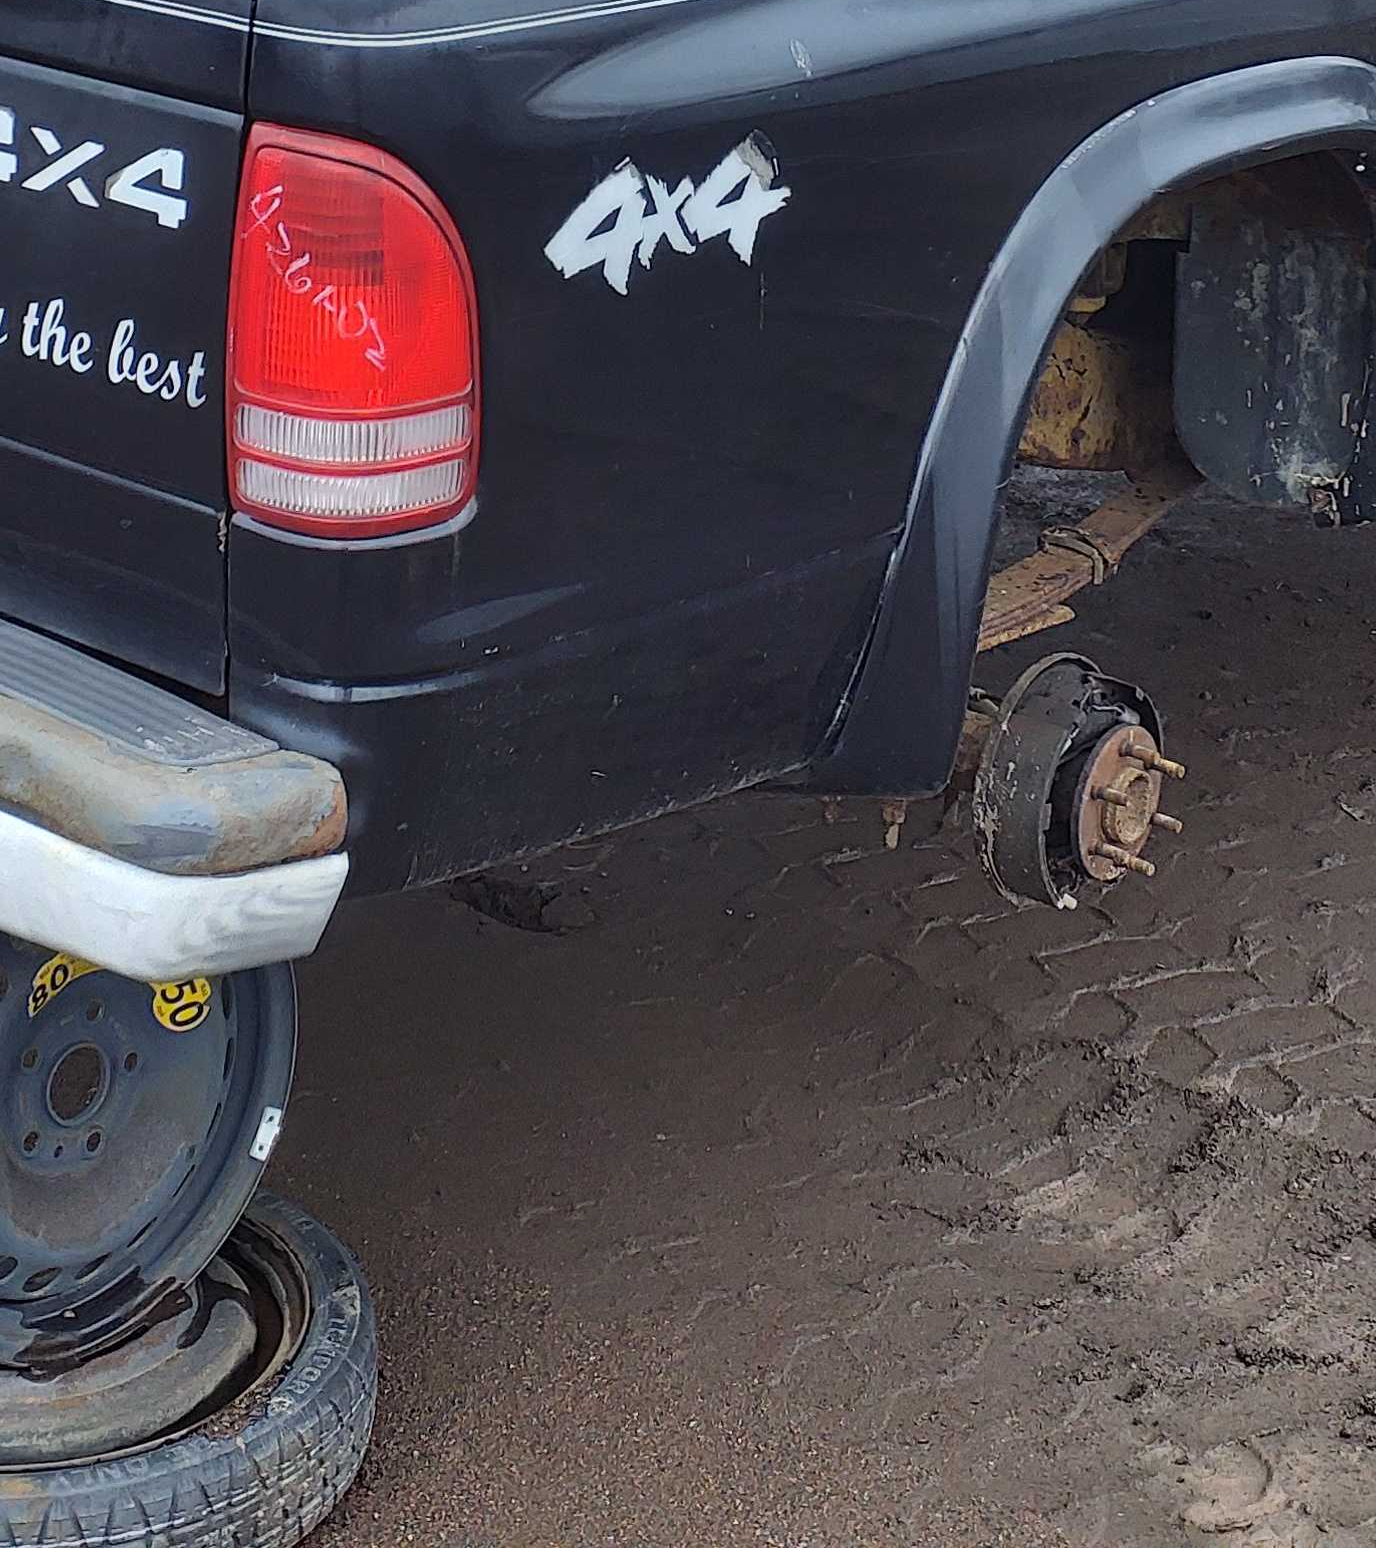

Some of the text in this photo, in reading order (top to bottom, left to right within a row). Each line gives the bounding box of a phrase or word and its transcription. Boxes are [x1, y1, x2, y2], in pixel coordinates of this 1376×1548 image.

[22, 297, 93, 373] the
[107, 319, 207, 408] best
[31, 963, 70, 1013] 80
[161, 979, 204, 1027] 50
